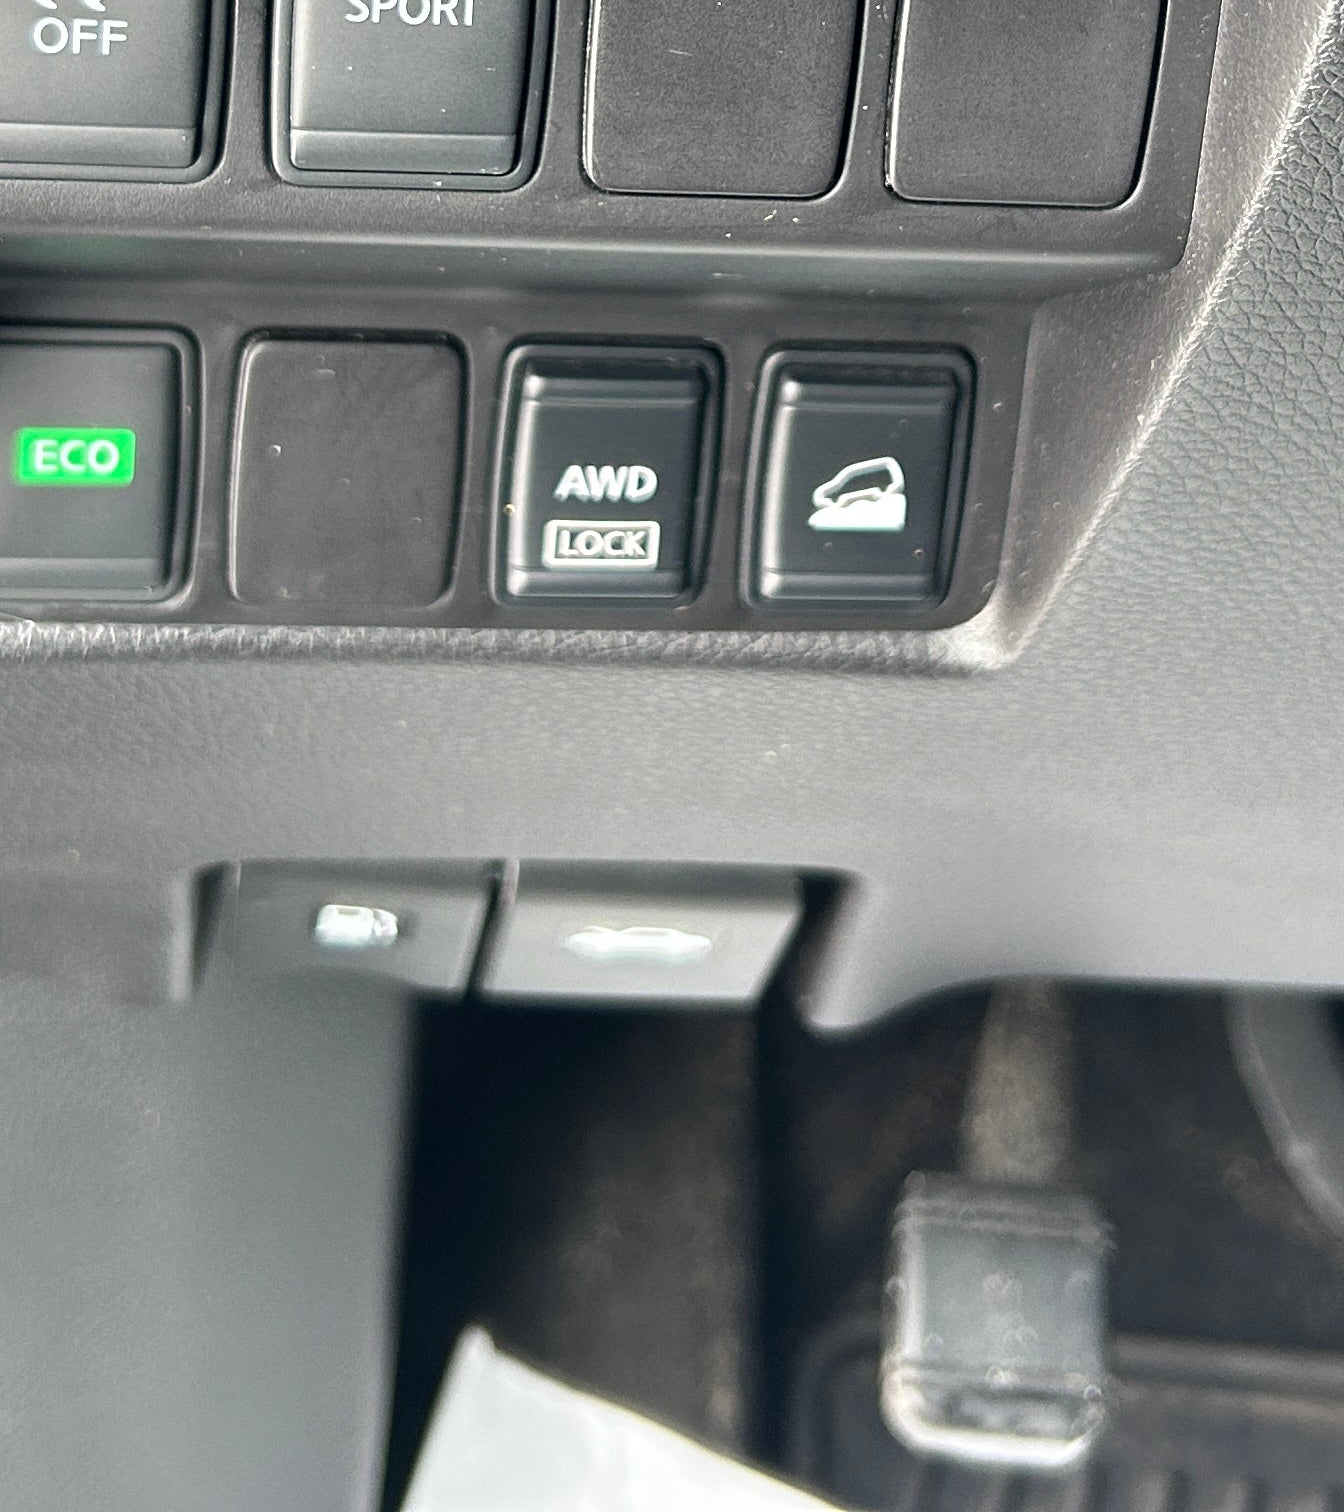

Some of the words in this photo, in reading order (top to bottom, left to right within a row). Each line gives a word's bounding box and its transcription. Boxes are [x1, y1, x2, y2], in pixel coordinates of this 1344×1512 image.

[32, 16, 129, 55] OFF
[32, 440, 121, 475] ECO
[554, 464, 658, 502] AWD
[559, 529, 645, 561] LOCK
